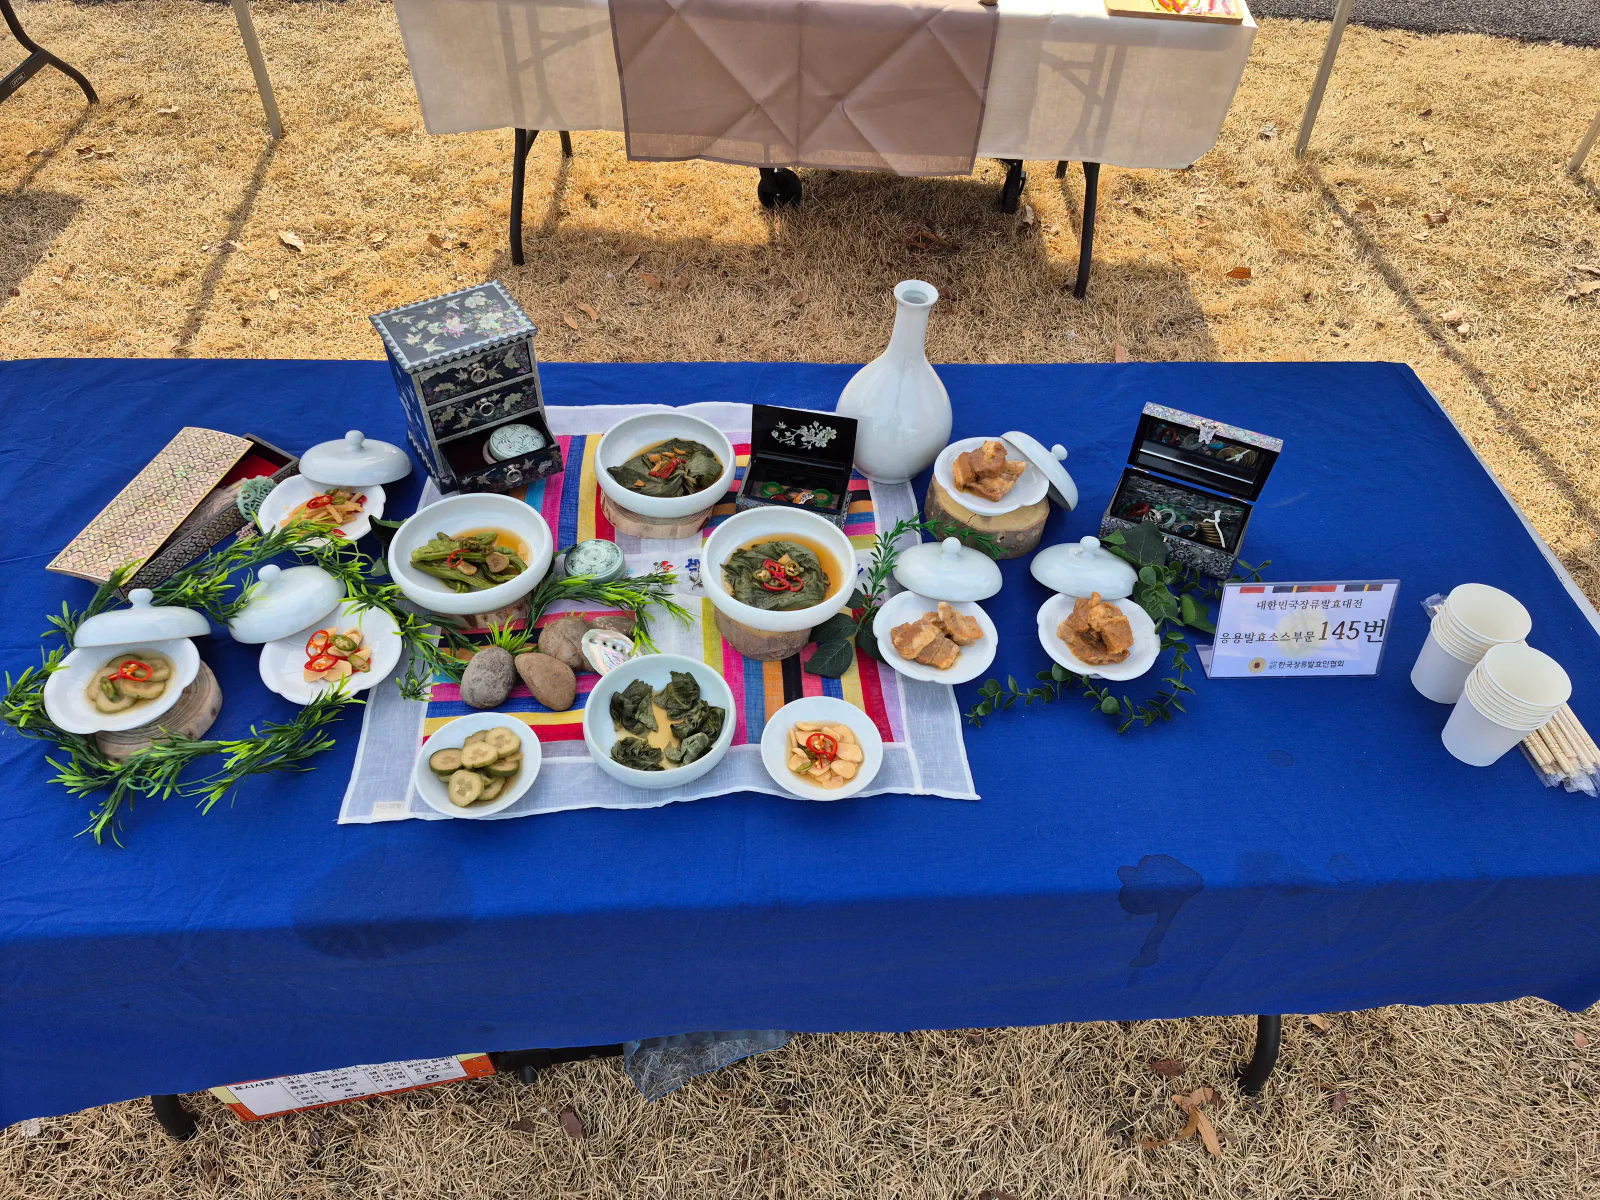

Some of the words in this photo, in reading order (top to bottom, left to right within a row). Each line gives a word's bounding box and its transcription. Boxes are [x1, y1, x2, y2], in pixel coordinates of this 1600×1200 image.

[1257, 598, 1363, 610] 대한민국장류발효대전
[1219, 631, 1315, 644] 응용발효소스부문
[1318, 619, 1386, 643] 145번
[1278, 660, 1345, 669] 한국장류발효인협회
